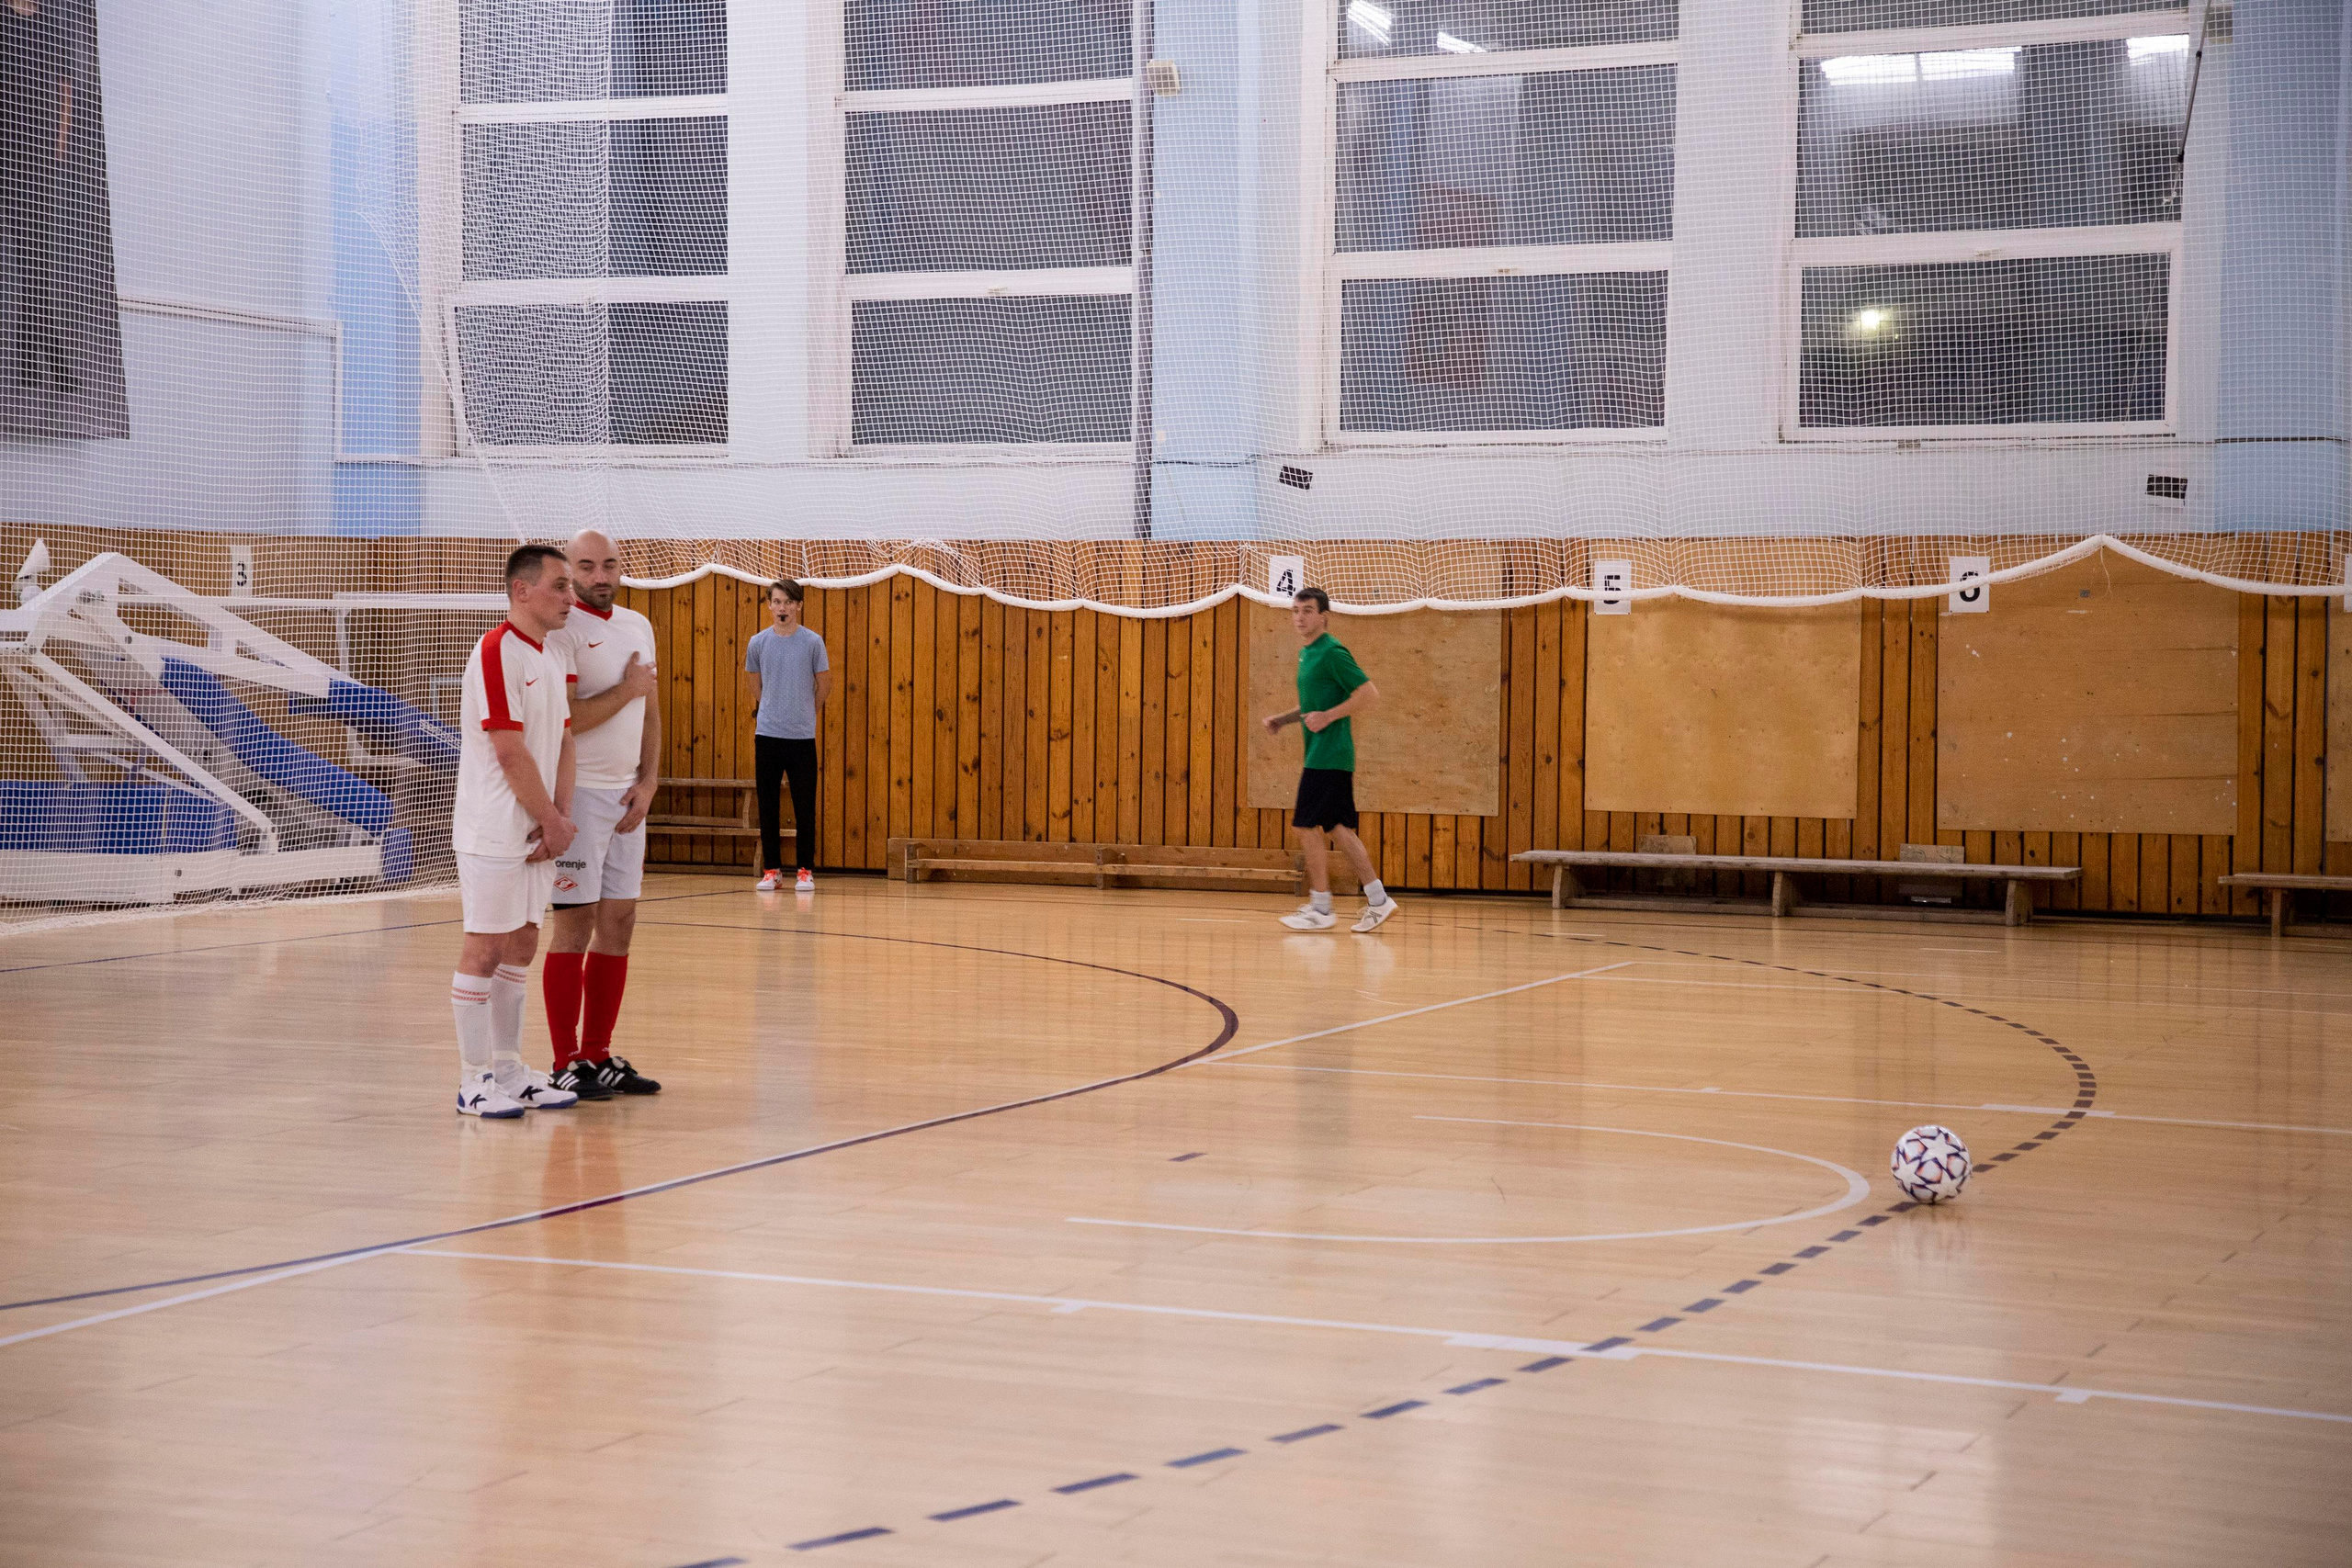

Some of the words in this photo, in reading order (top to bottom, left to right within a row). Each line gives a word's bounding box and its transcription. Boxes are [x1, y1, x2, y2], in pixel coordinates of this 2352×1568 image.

[236, 561, 247, 587] 3
[1276, 569, 1295, 598] 4
[1959, 570, 1980, 603] 6
[1603, 574, 1623, 605] 5
[555, 860, 586, 871] orenje
